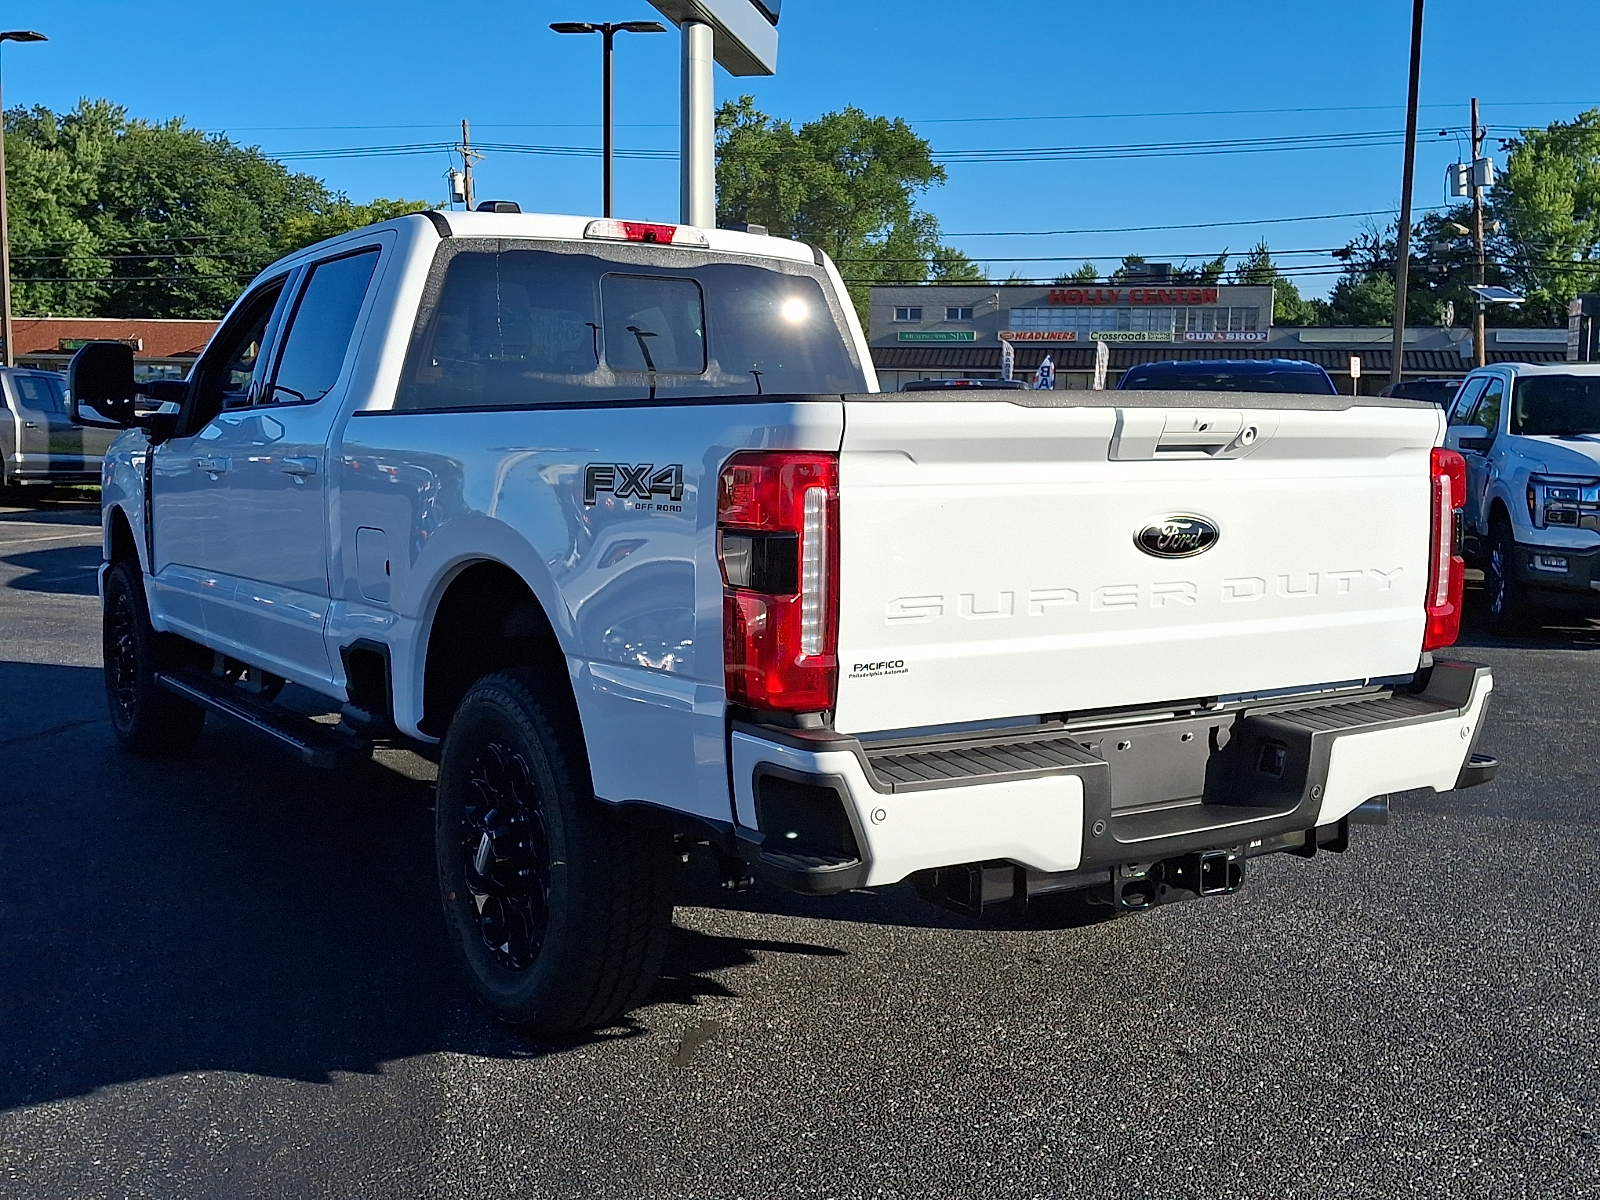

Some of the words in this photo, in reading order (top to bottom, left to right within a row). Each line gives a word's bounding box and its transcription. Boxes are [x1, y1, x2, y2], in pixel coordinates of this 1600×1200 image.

[1048, 289, 1121, 304] HOLLY
[1128, 288, 1217, 304] CENTER
[950, 332, 968, 340] SPA
[1014, 331, 1076, 340] HEADLINERS
[1090, 331, 1146, 340] Crossroads
[1185, 332, 1215, 340] GUN
[1225, 332, 1267, 340] SHOP
[583, 463, 684, 506] FX4
[656, 504, 683, 512] ROAD
[1156, 518, 1204, 550] Ford
[885, 581, 1197, 625] SUPER
[1220, 567, 1404, 603] DUTY
[853, 660, 904, 672] PACIFICO
[848, 670, 883, 679] Philadelphia
[884, 667, 909, 676] Automall
